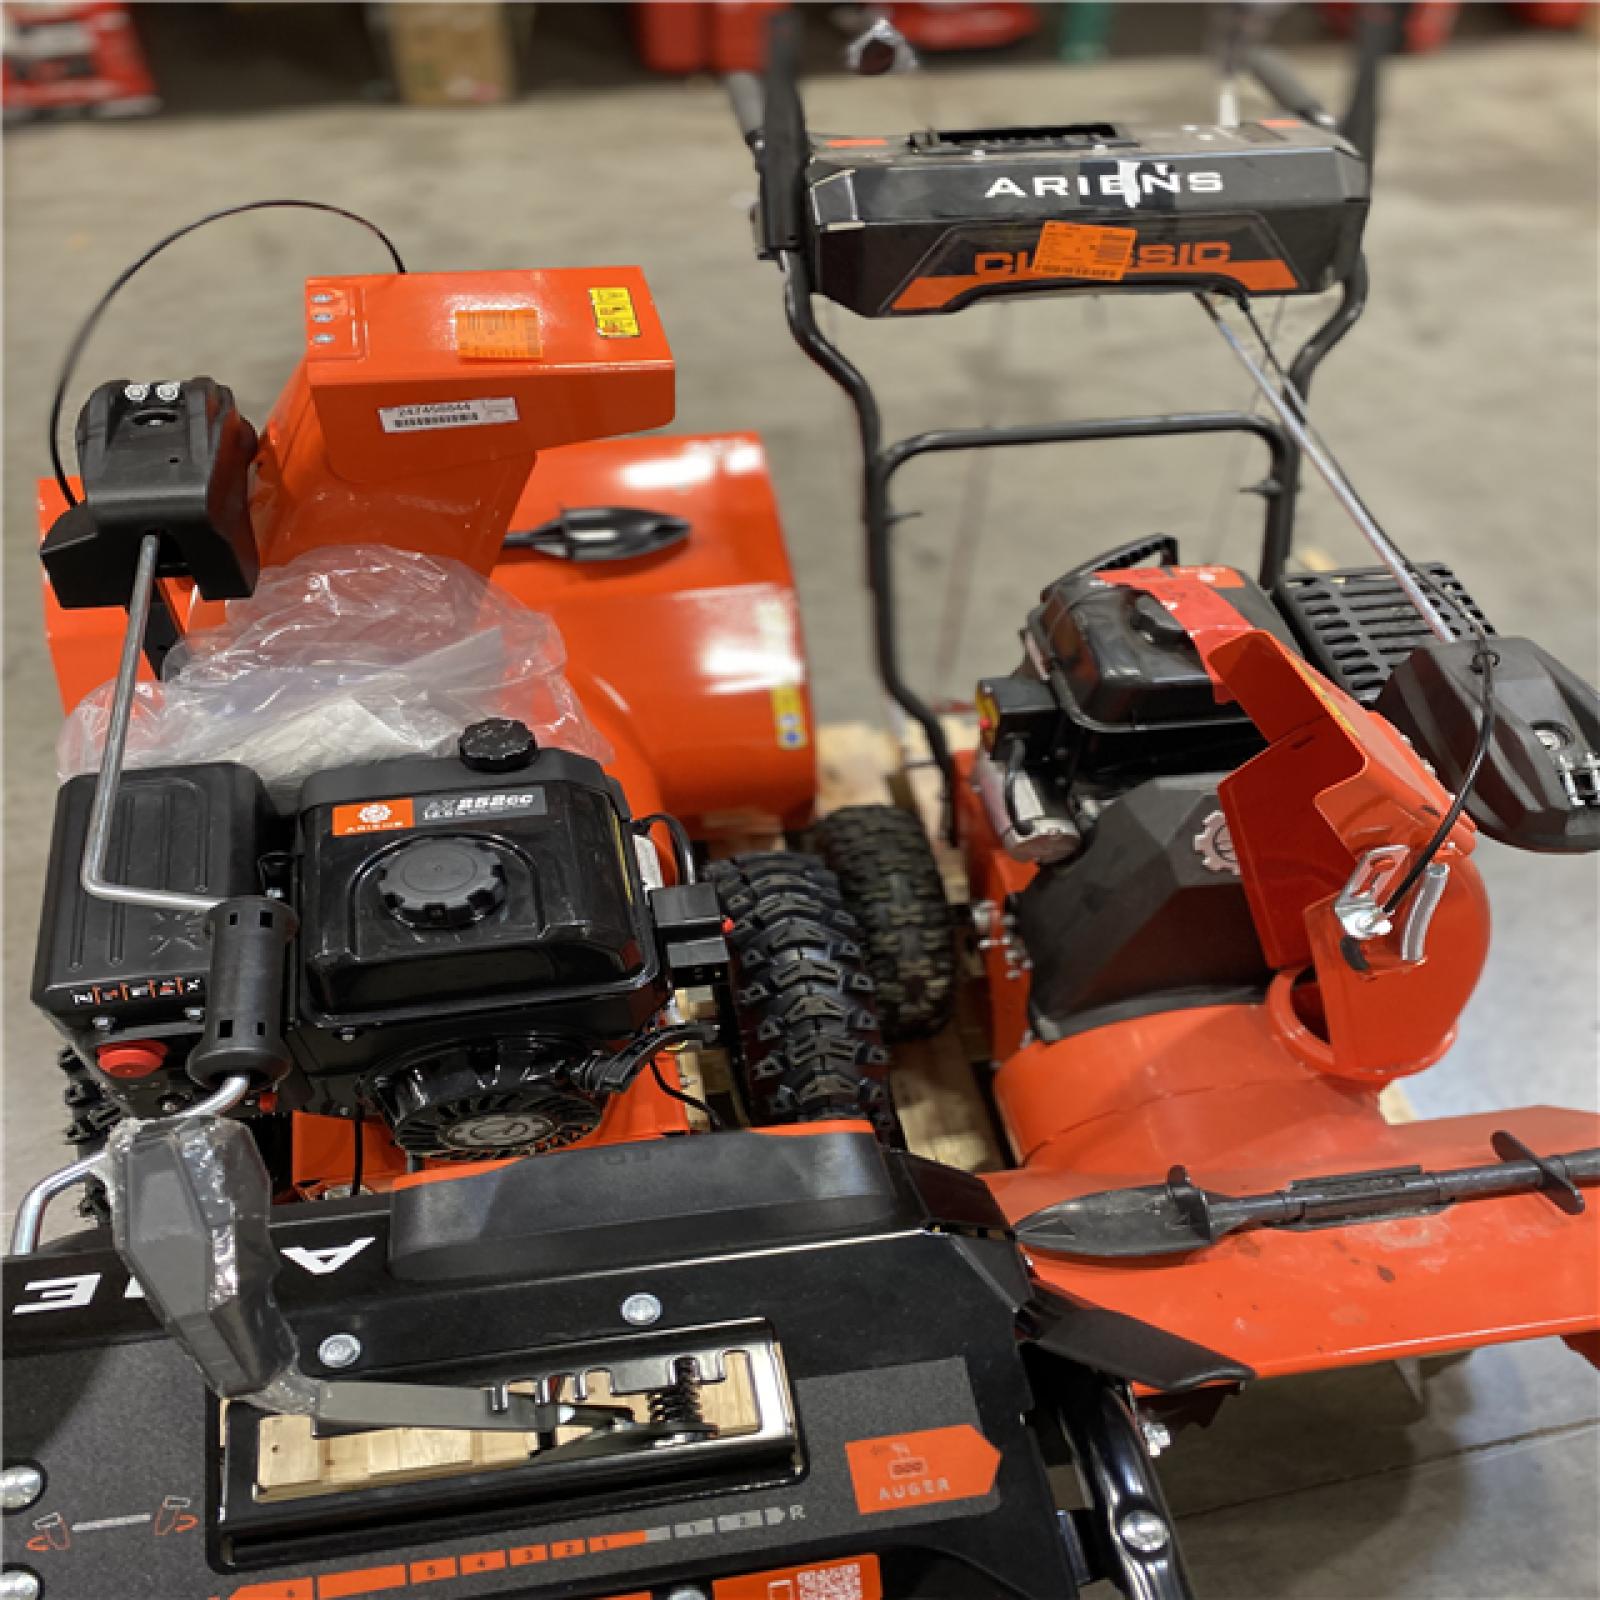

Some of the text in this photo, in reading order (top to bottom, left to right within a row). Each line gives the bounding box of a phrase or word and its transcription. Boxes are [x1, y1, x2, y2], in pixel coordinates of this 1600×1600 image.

[985, 171, 1223, 198] ARIENS
[975, 241, 1232, 276] CLSIC
[879, 1476, 950, 1501] AUGER
[789, 1504, 806, 1521] R
